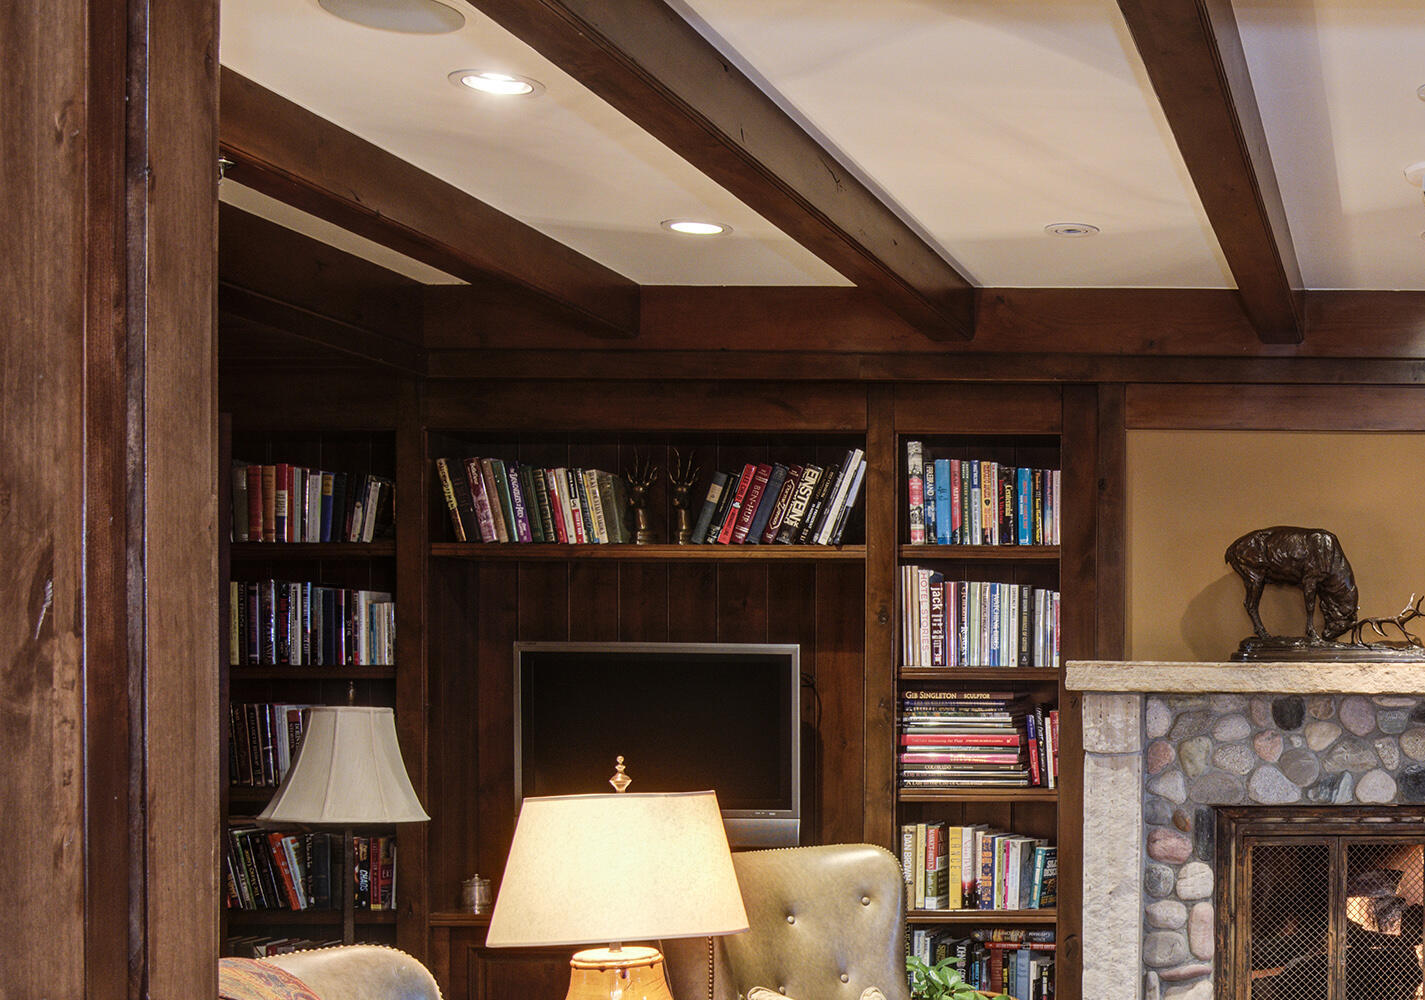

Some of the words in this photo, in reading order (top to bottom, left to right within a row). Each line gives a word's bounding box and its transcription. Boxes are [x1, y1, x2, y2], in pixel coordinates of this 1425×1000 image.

[742, 484, 761, 523] BEN-HUR
[789, 468, 820, 522] EINSTEIN
[1004, 484, 1013, 516] Centennial
[919, 572, 928, 605] HOTEL
[930, 587, 944, 611] jack
[921, 608, 929, 651] STORIES
[905, 691, 918, 699] GIB
[919, 691, 957, 699] SINGLETON
[903, 834, 912, 850] DAN
[359, 869, 369, 892] CHAOS
[903, 851, 913, 881] BROWN
